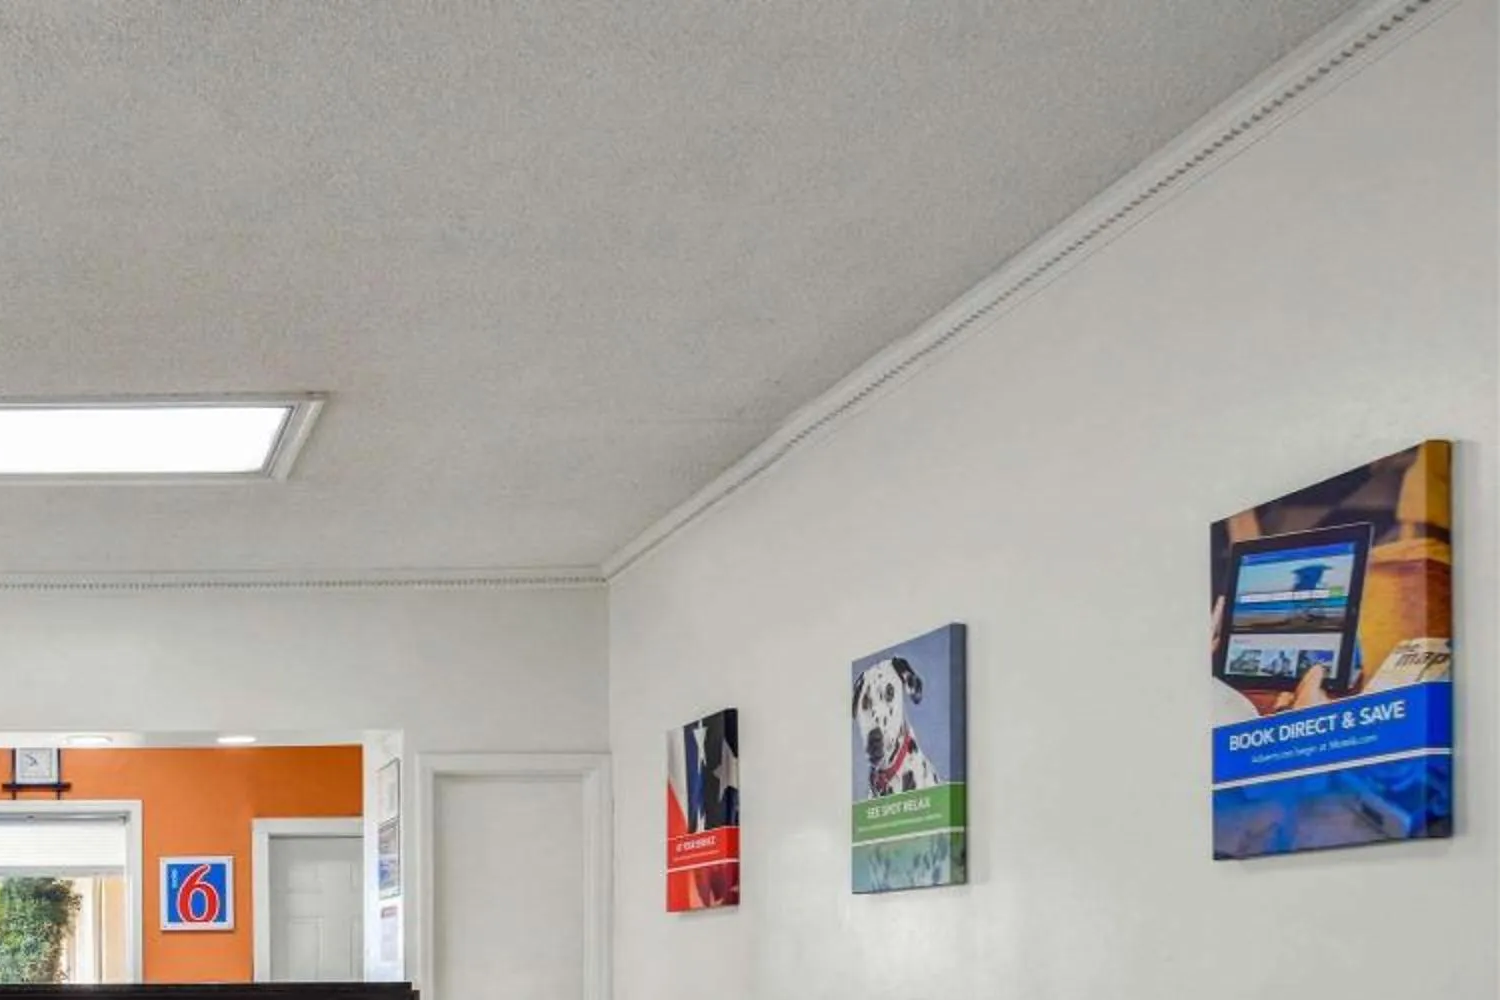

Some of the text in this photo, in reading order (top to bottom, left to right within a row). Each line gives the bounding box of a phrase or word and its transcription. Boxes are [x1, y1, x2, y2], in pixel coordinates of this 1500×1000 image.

[1229, 700, 1406, 752] BOOK DIRECT & SAVE
[177, 864, 220, 923] 6
